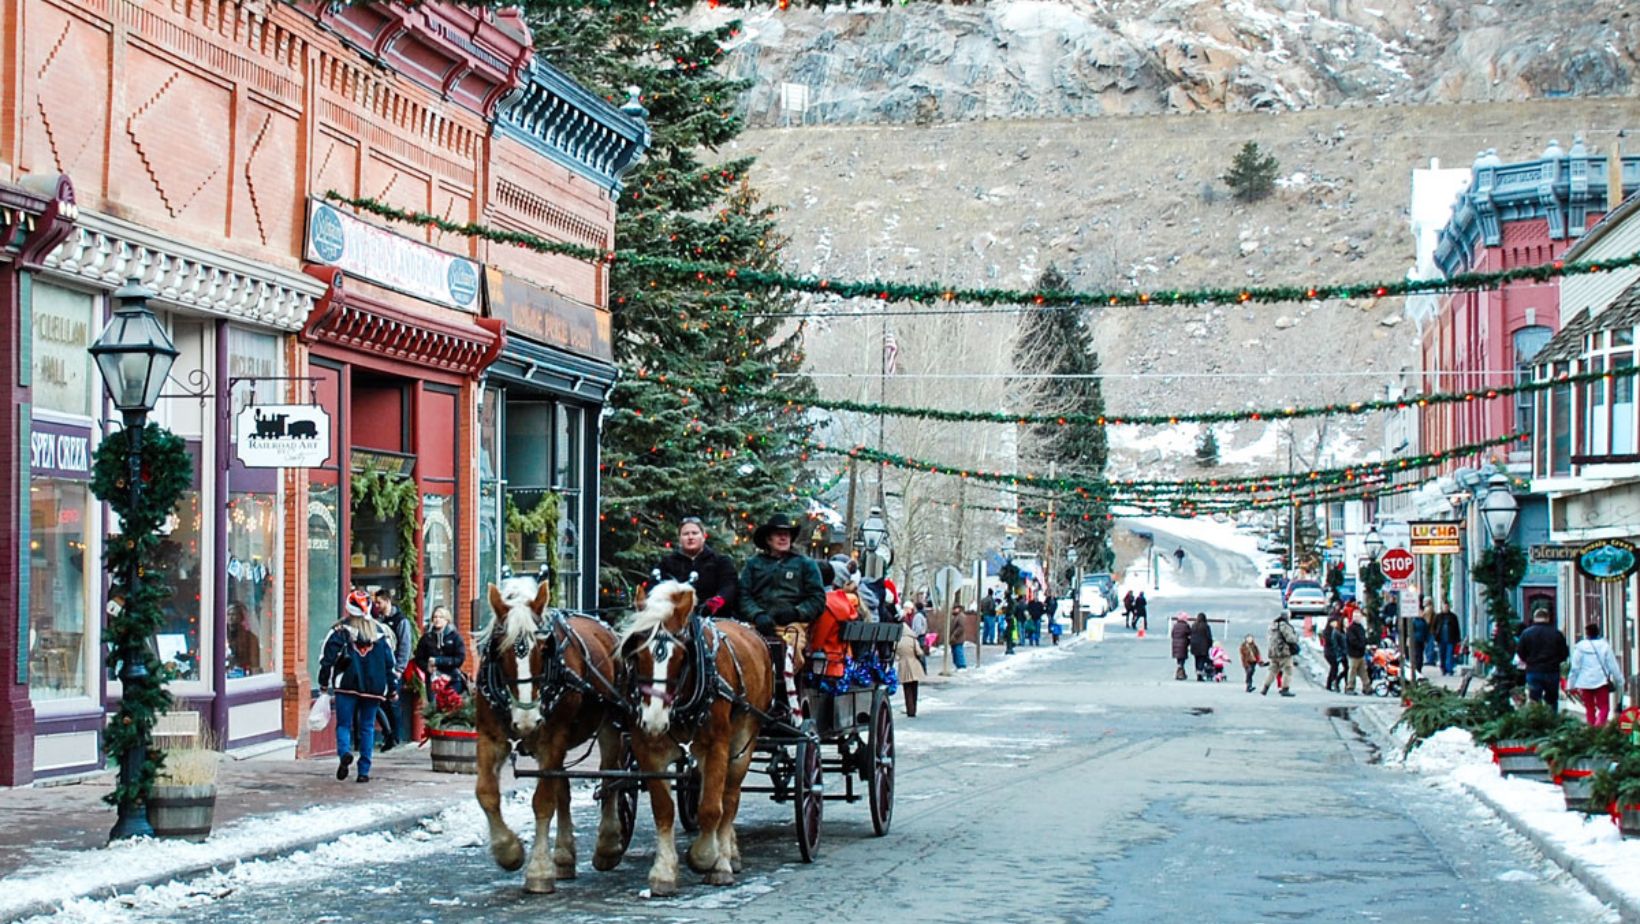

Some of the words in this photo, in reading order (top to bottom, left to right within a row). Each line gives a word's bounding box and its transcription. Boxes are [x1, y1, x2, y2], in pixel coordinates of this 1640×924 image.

[249, 440, 297, 449] RAILROAD
[300, 440, 318, 449] ART
[31, 431, 55, 469] SPEN
[57, 435, 88, 472] CREEK
[1413, 526, 1457, 537] LUCHA
[1382, 557, 1413, 571] STOP
